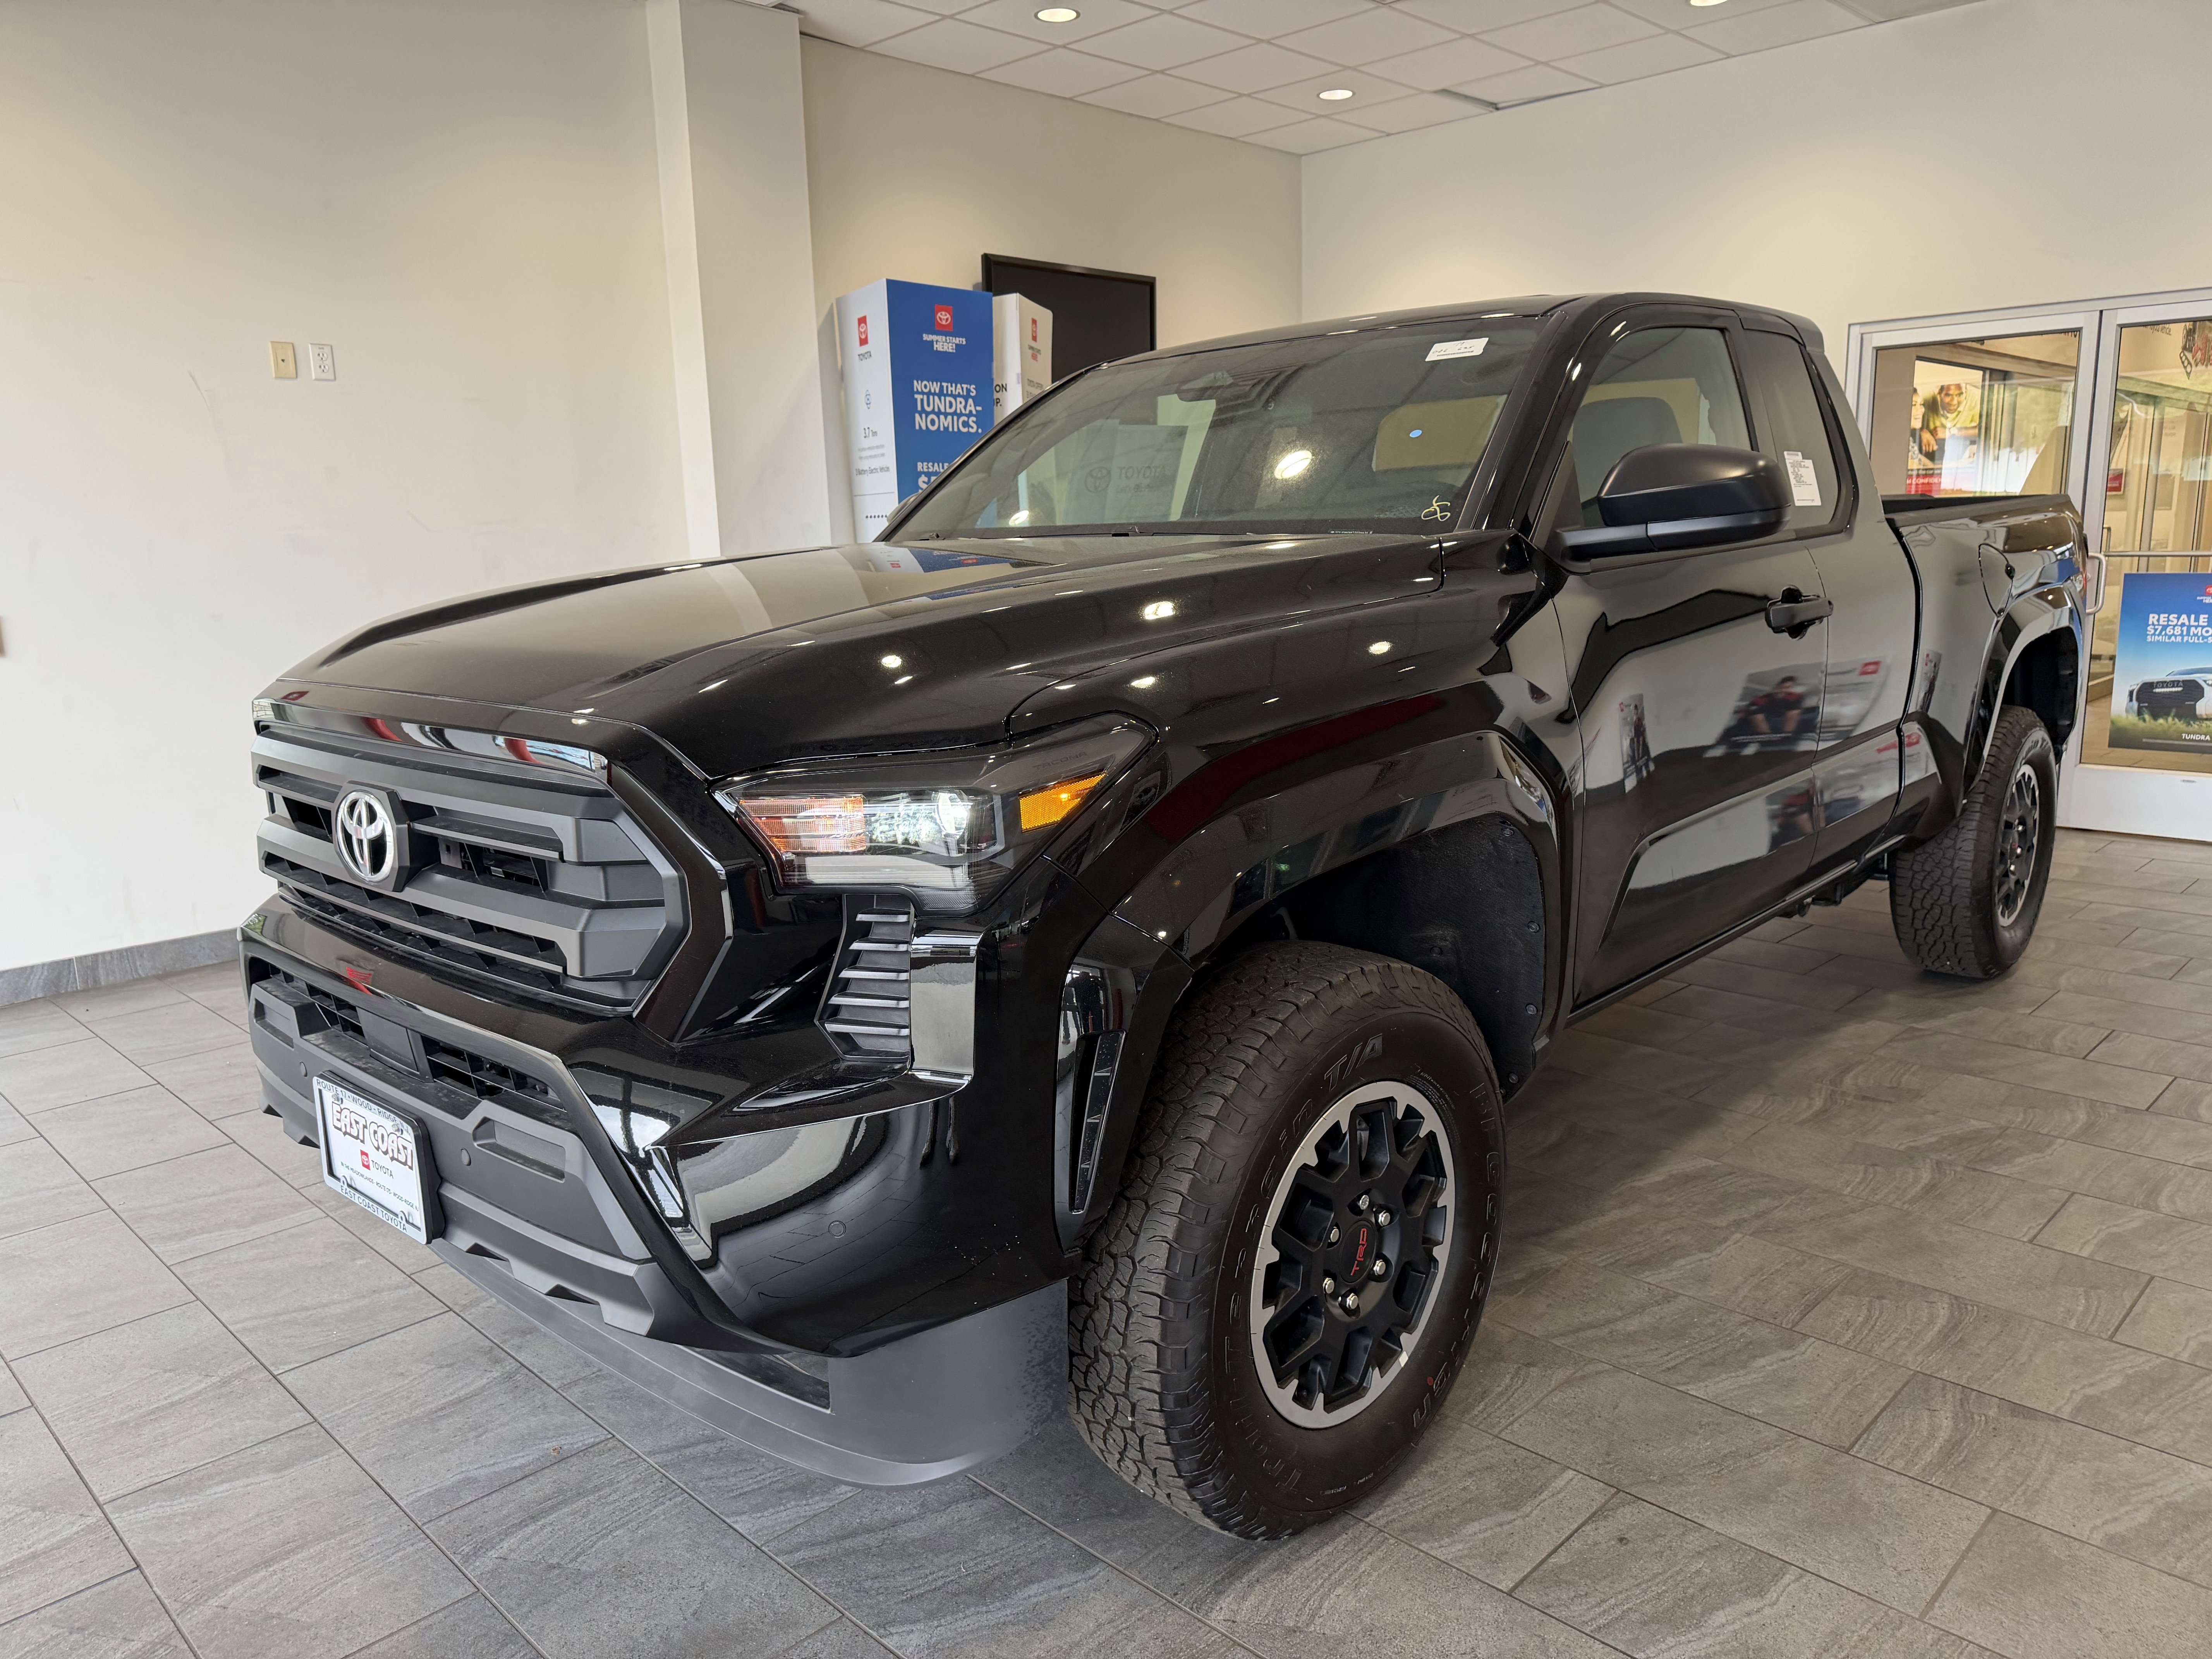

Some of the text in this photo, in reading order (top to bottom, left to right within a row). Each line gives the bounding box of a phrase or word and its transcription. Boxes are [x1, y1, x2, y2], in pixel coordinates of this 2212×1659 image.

[922, 333, 967, 345] SUMMER STARTS
[934, 341, 956, 352] HERE!
[914, 380, 976, 396] NOW THAT'S
[914, 394, 982, 414] TUNDRA-
[915, 413, 982, 433] NOMICS.
[2148, 613, 2209, 626] RESALE
[2147, 625, 2187, 635] $7,681
[1032, 751, 1087, 770] TACOMA
[1324, 1033, 1383, 1093] T/A
[316, 1079, 339, 1095] ROUTE
[340, 1090, 347, 1099] 17
[351, 1095, 372, 1111] WOOD
[332, 1101, 414, 1171] EAST COAST
[350, 1167, 374, 1184] MEADOWLANDS
[376, 1181, 386, 1191] ROUTE
[371, 1160, 394, 1179] TOYOTA
[340, 1185, 407, 1233] EAST COAST TOYOTA
[1350, 1228, 1367, 1276] TRD
